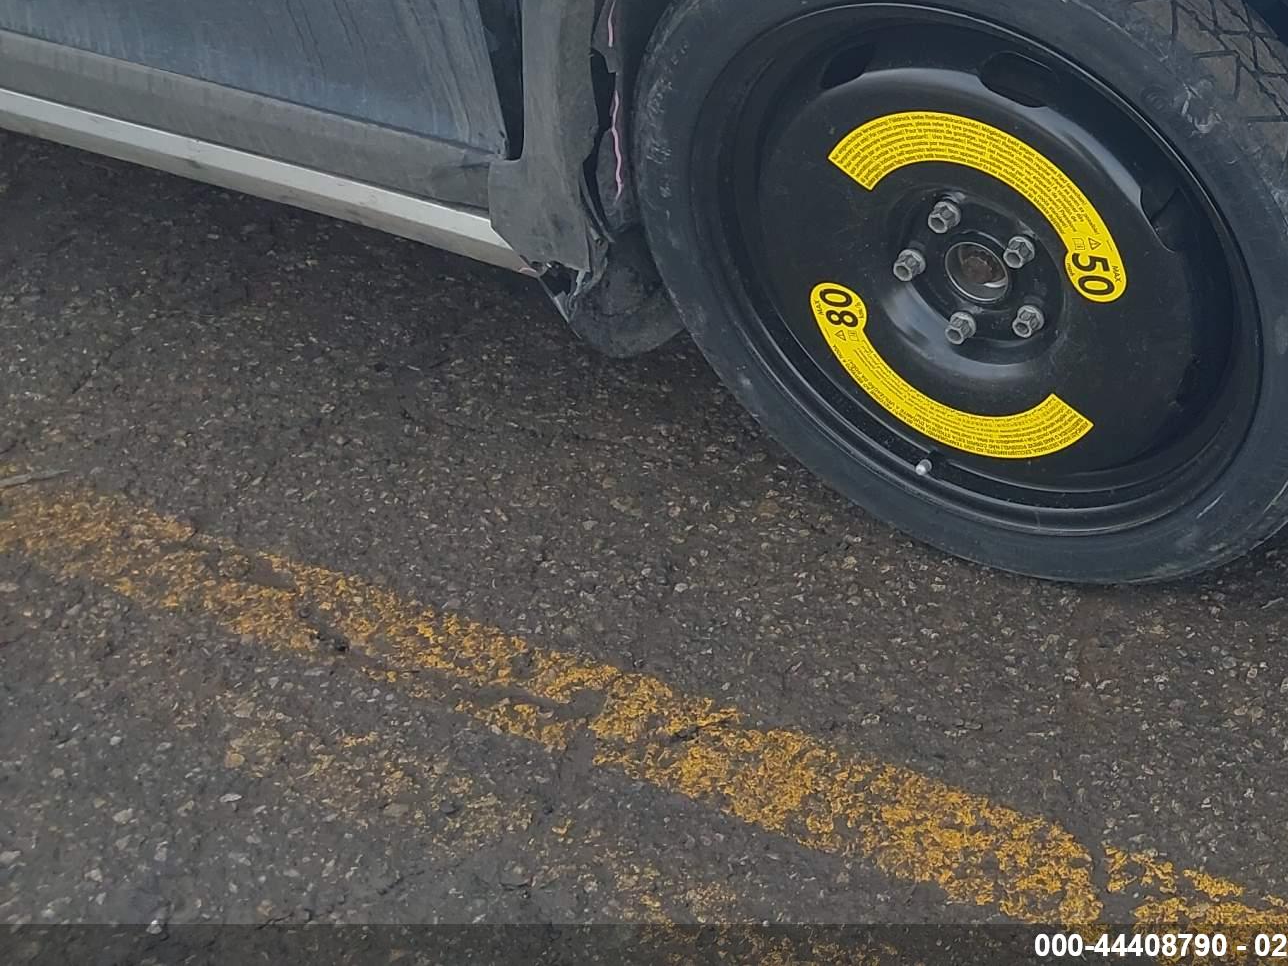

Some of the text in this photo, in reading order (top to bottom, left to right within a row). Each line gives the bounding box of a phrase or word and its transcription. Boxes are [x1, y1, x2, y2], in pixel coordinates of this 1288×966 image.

[1072, 253, 1115, 295] 50
[1112, 265, 1121, 282] MAX
[815, 300, 823, 315] MAX
[820, 289, 858, 327] 80
